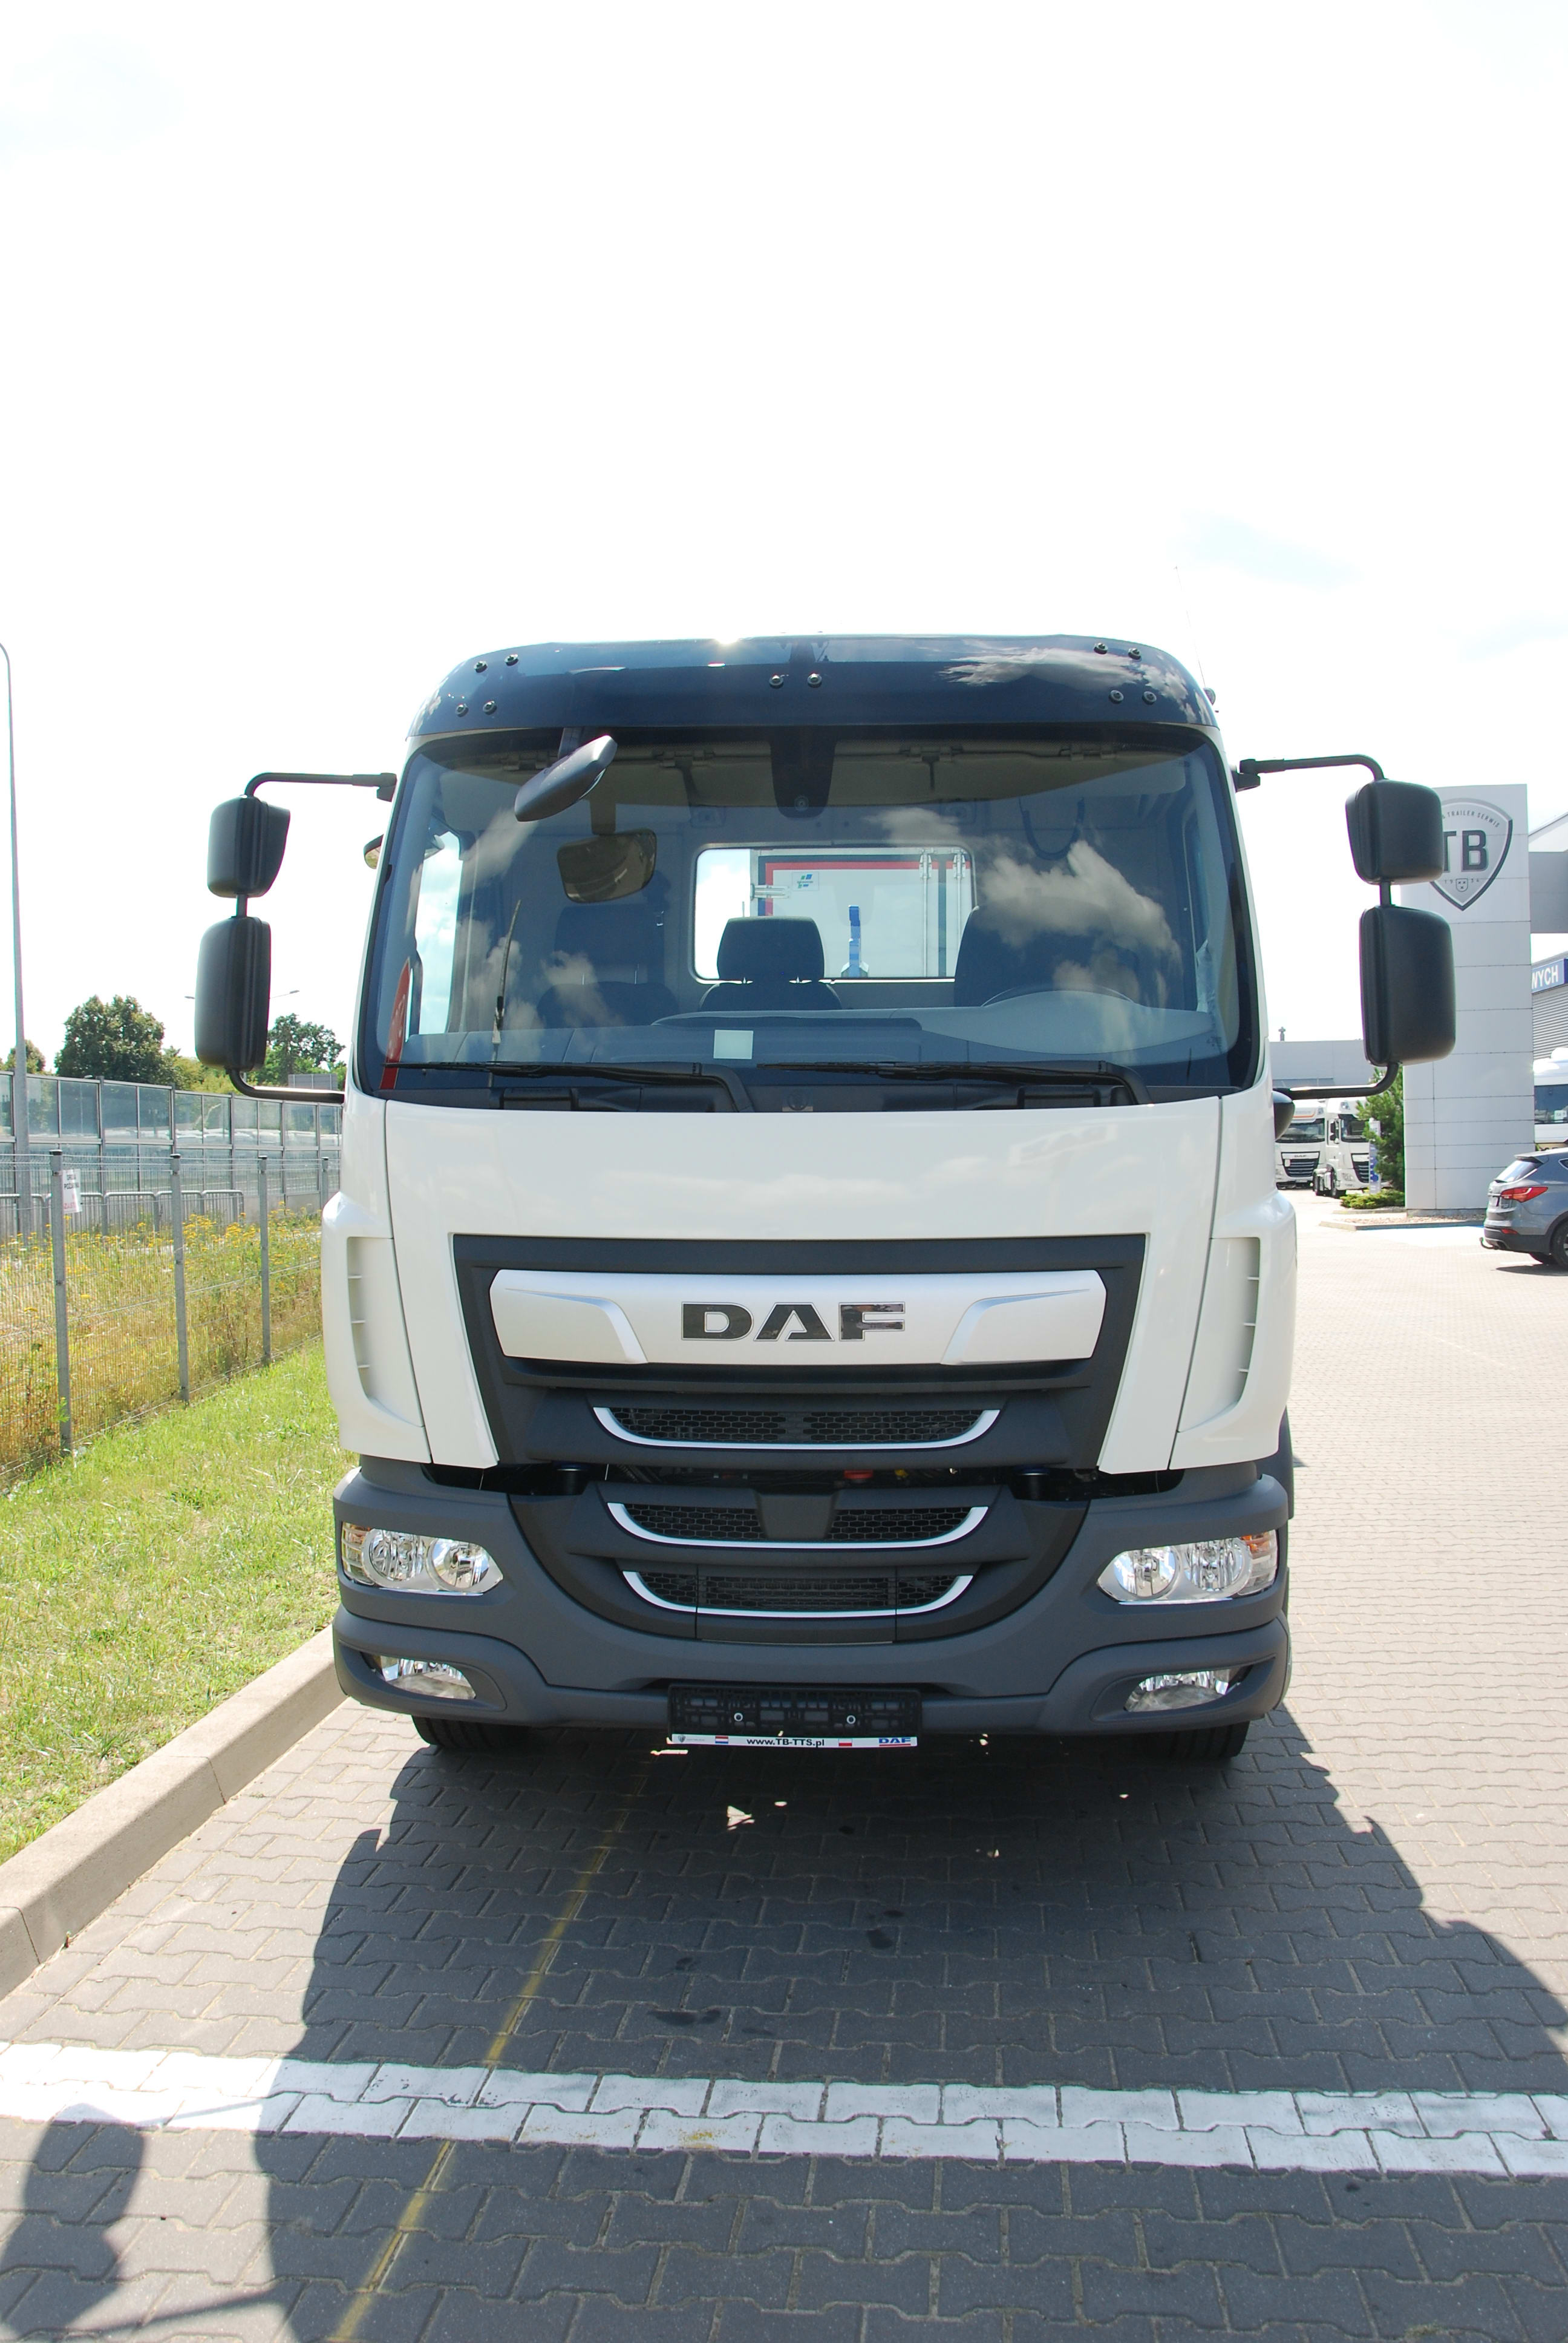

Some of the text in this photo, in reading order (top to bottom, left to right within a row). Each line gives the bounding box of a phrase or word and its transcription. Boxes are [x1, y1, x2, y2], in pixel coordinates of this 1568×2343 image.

[1443, 830, 1489, 873] TB
[681, 1302, 905, 1342] DAF
[746, 1738, 825, 1748] www.TB-TTS.pl
